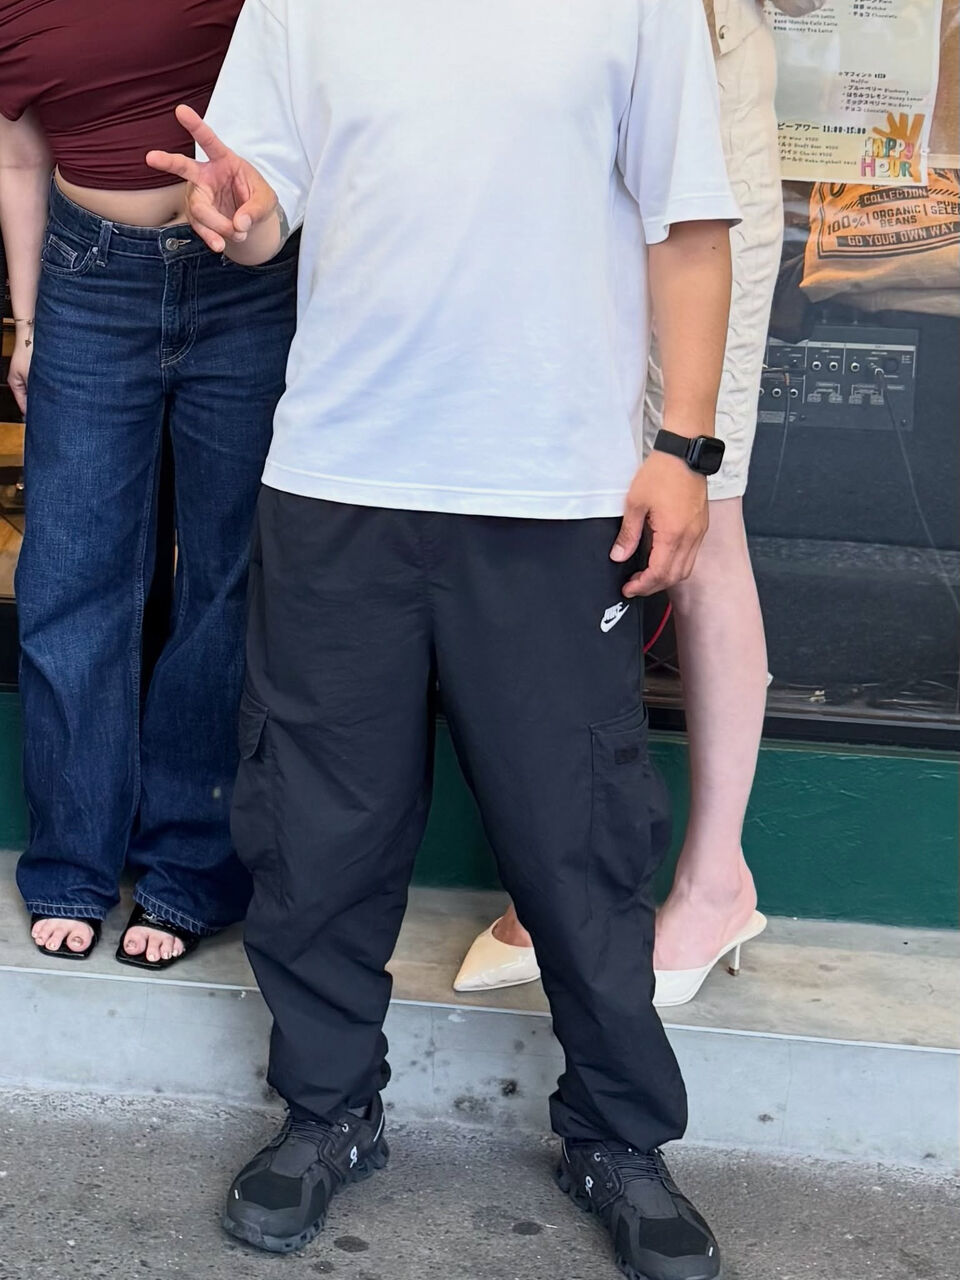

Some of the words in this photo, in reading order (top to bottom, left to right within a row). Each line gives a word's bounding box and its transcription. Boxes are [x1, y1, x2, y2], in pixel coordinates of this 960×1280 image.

[864, 188, 928, 205] COLLECTION
[827, 214, 866, 235] 100%
[872, 204, 922, 220] ORGANIC
[880, 214, 918, 228] BEANS
[847, 235, 865, 246] GO
[866, 233, 897, 245] YOUR
[900, 228, 927, 242] OWN
[930, 222, 955, 236] WAY
